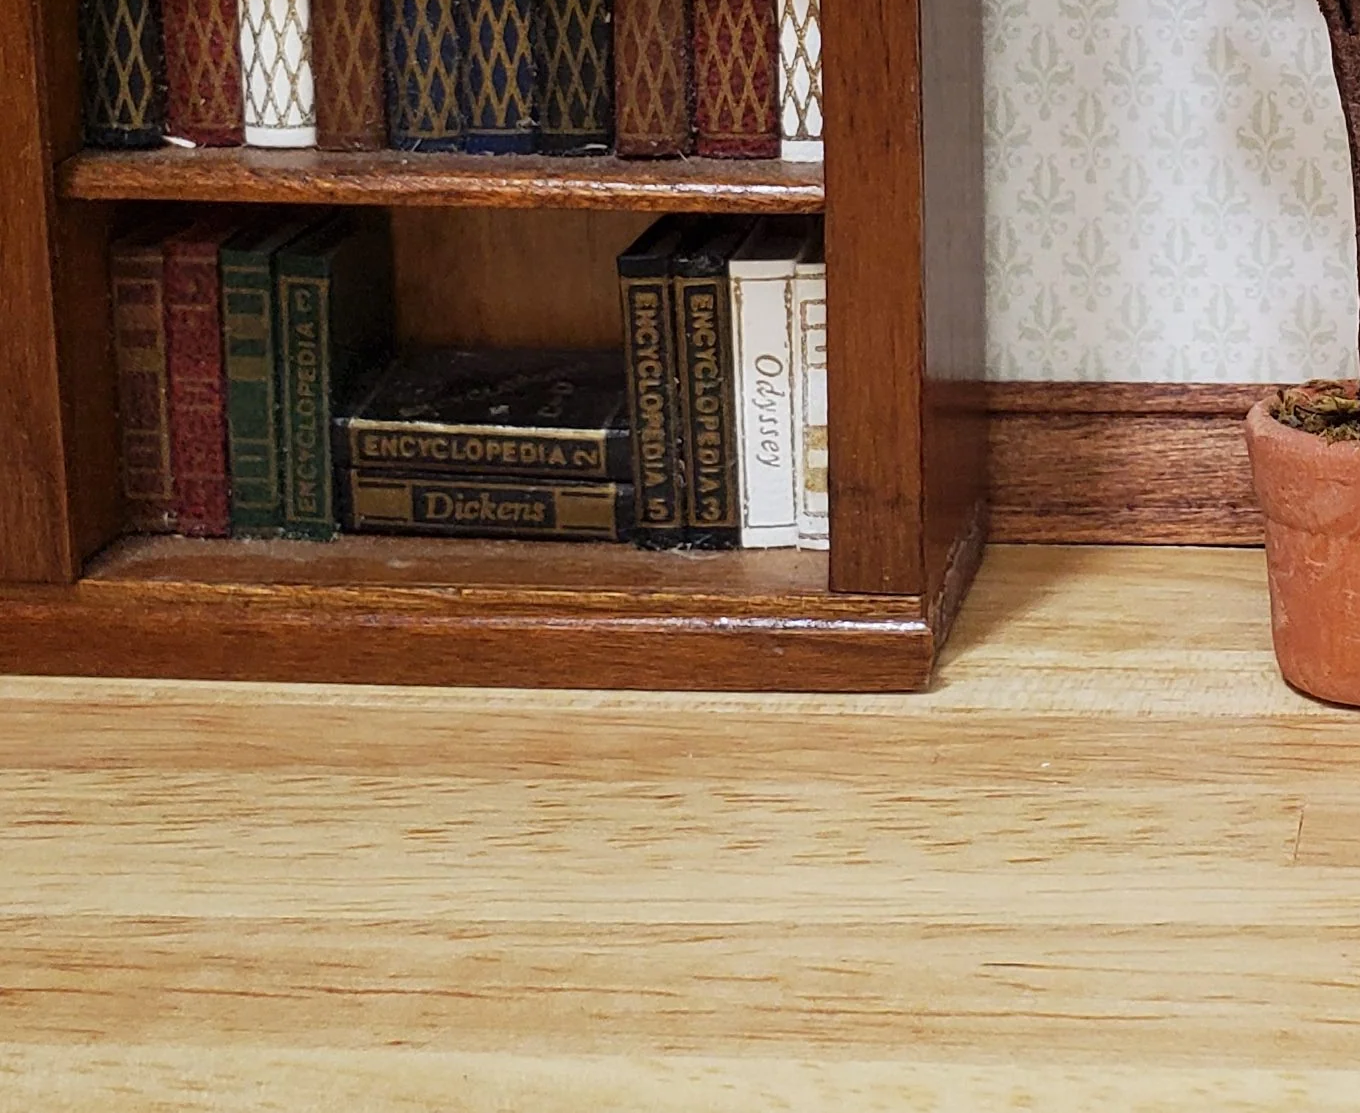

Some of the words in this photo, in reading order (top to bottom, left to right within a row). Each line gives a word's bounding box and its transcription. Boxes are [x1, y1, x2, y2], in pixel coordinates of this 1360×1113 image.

[296, 322, 316, 513] ENCYCLOPEDIA
[634, 292, 666, 487] ENCYCLOPEDIA
[690, 293, 721, 493] ENCYCLOPEDIA
[753, 355, 783, 467] Odyssey
[364, 435, 567, 466] ENCYCLOPEDIA
[425, 491, 546, 523] Dickens
[648, 498, 668, 520] 5
[701, 497, 721, 521] 3
